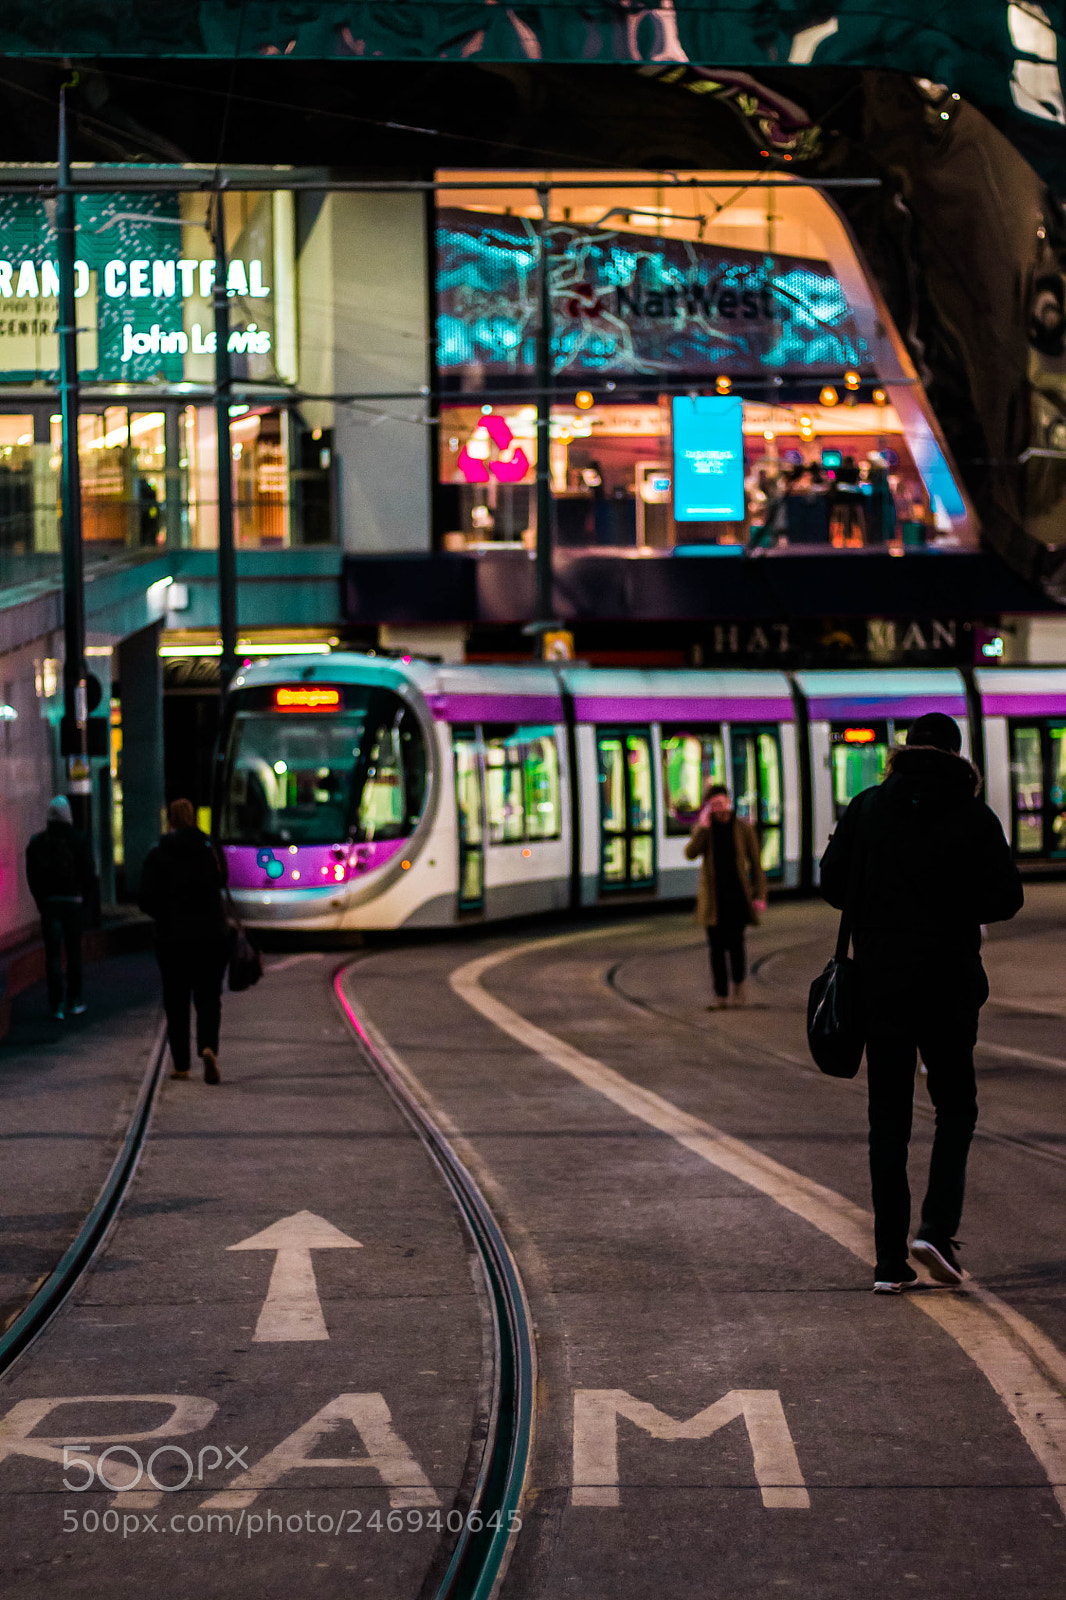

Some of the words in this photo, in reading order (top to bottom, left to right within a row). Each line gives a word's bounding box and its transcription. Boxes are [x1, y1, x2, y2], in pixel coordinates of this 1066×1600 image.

[104, 259, 270, 298] CENTRAL
[616, 282, 774, 319] NatWest
[120, 323, 188, 362] John
[191, 322, 271, 354] Lewis
